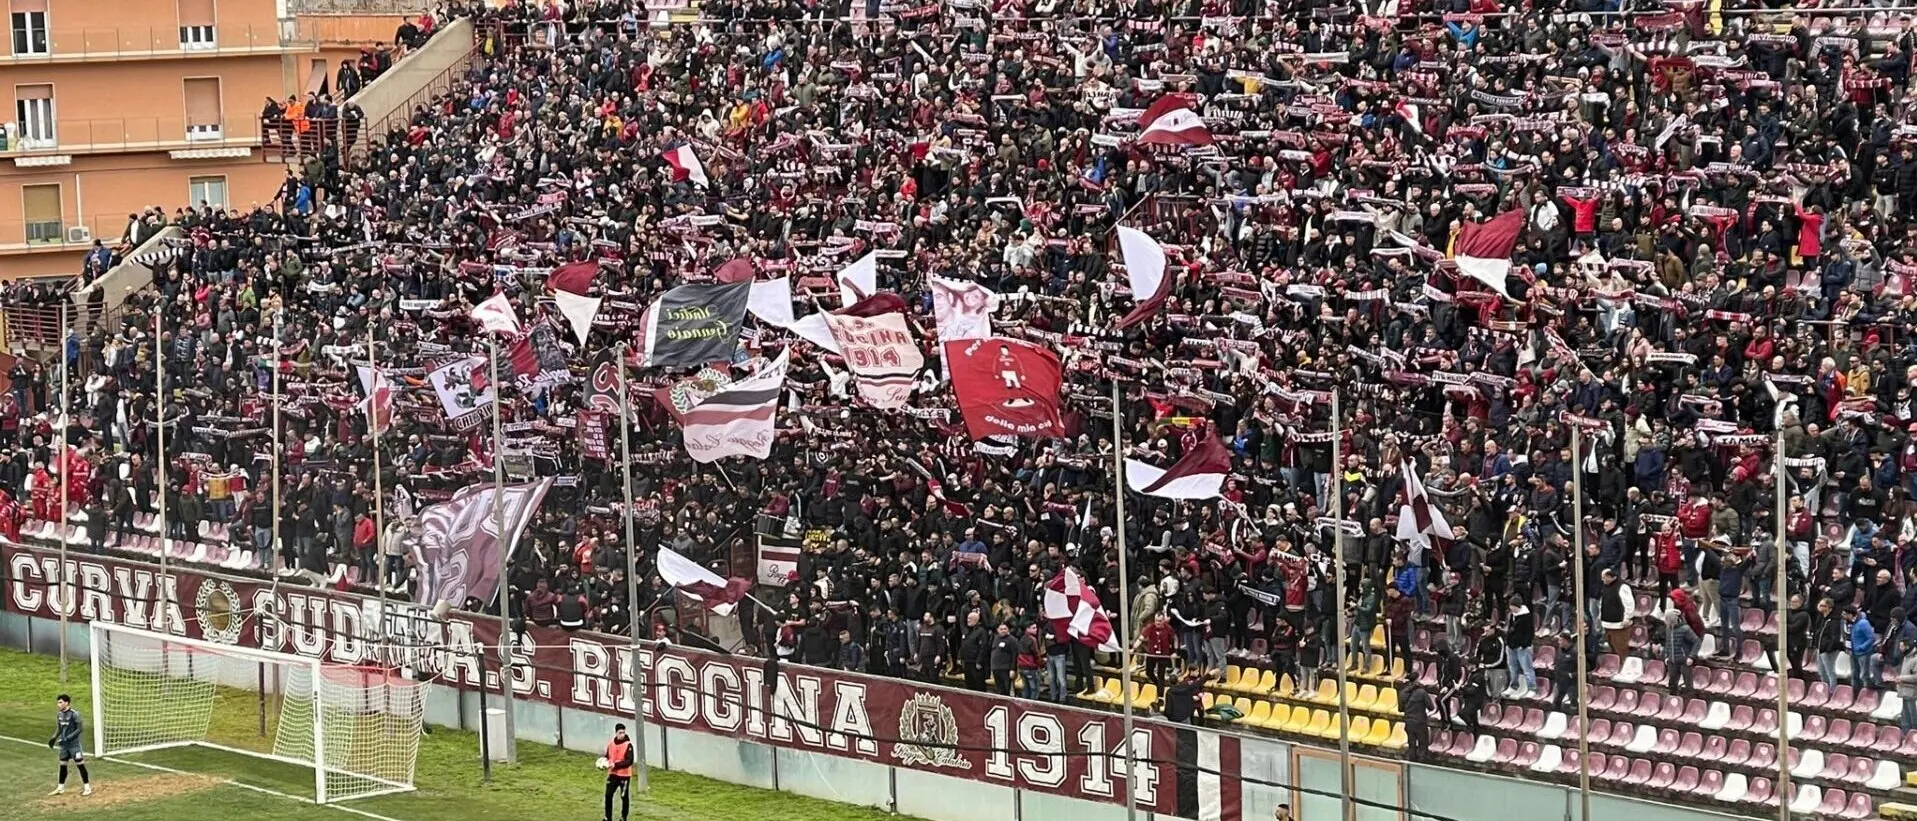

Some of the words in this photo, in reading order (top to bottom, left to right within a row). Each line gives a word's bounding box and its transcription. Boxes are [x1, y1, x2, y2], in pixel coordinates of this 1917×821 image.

[843, 347, 900, 368] 1914
[984, 415, 1015, 430] della
[1017, 423, 1037, 432] mia
[767, 563, 789, 585] Regg
[10, 552, 187, 635] CURVA
[253, 588, 363, 665] SUD
[444, 619, 551, 697] A.S.
[571, 637, 878, 757] REGGINA
[984, 705, 1160, 807] 1914
[933, 747, 972, 769] Calabria
